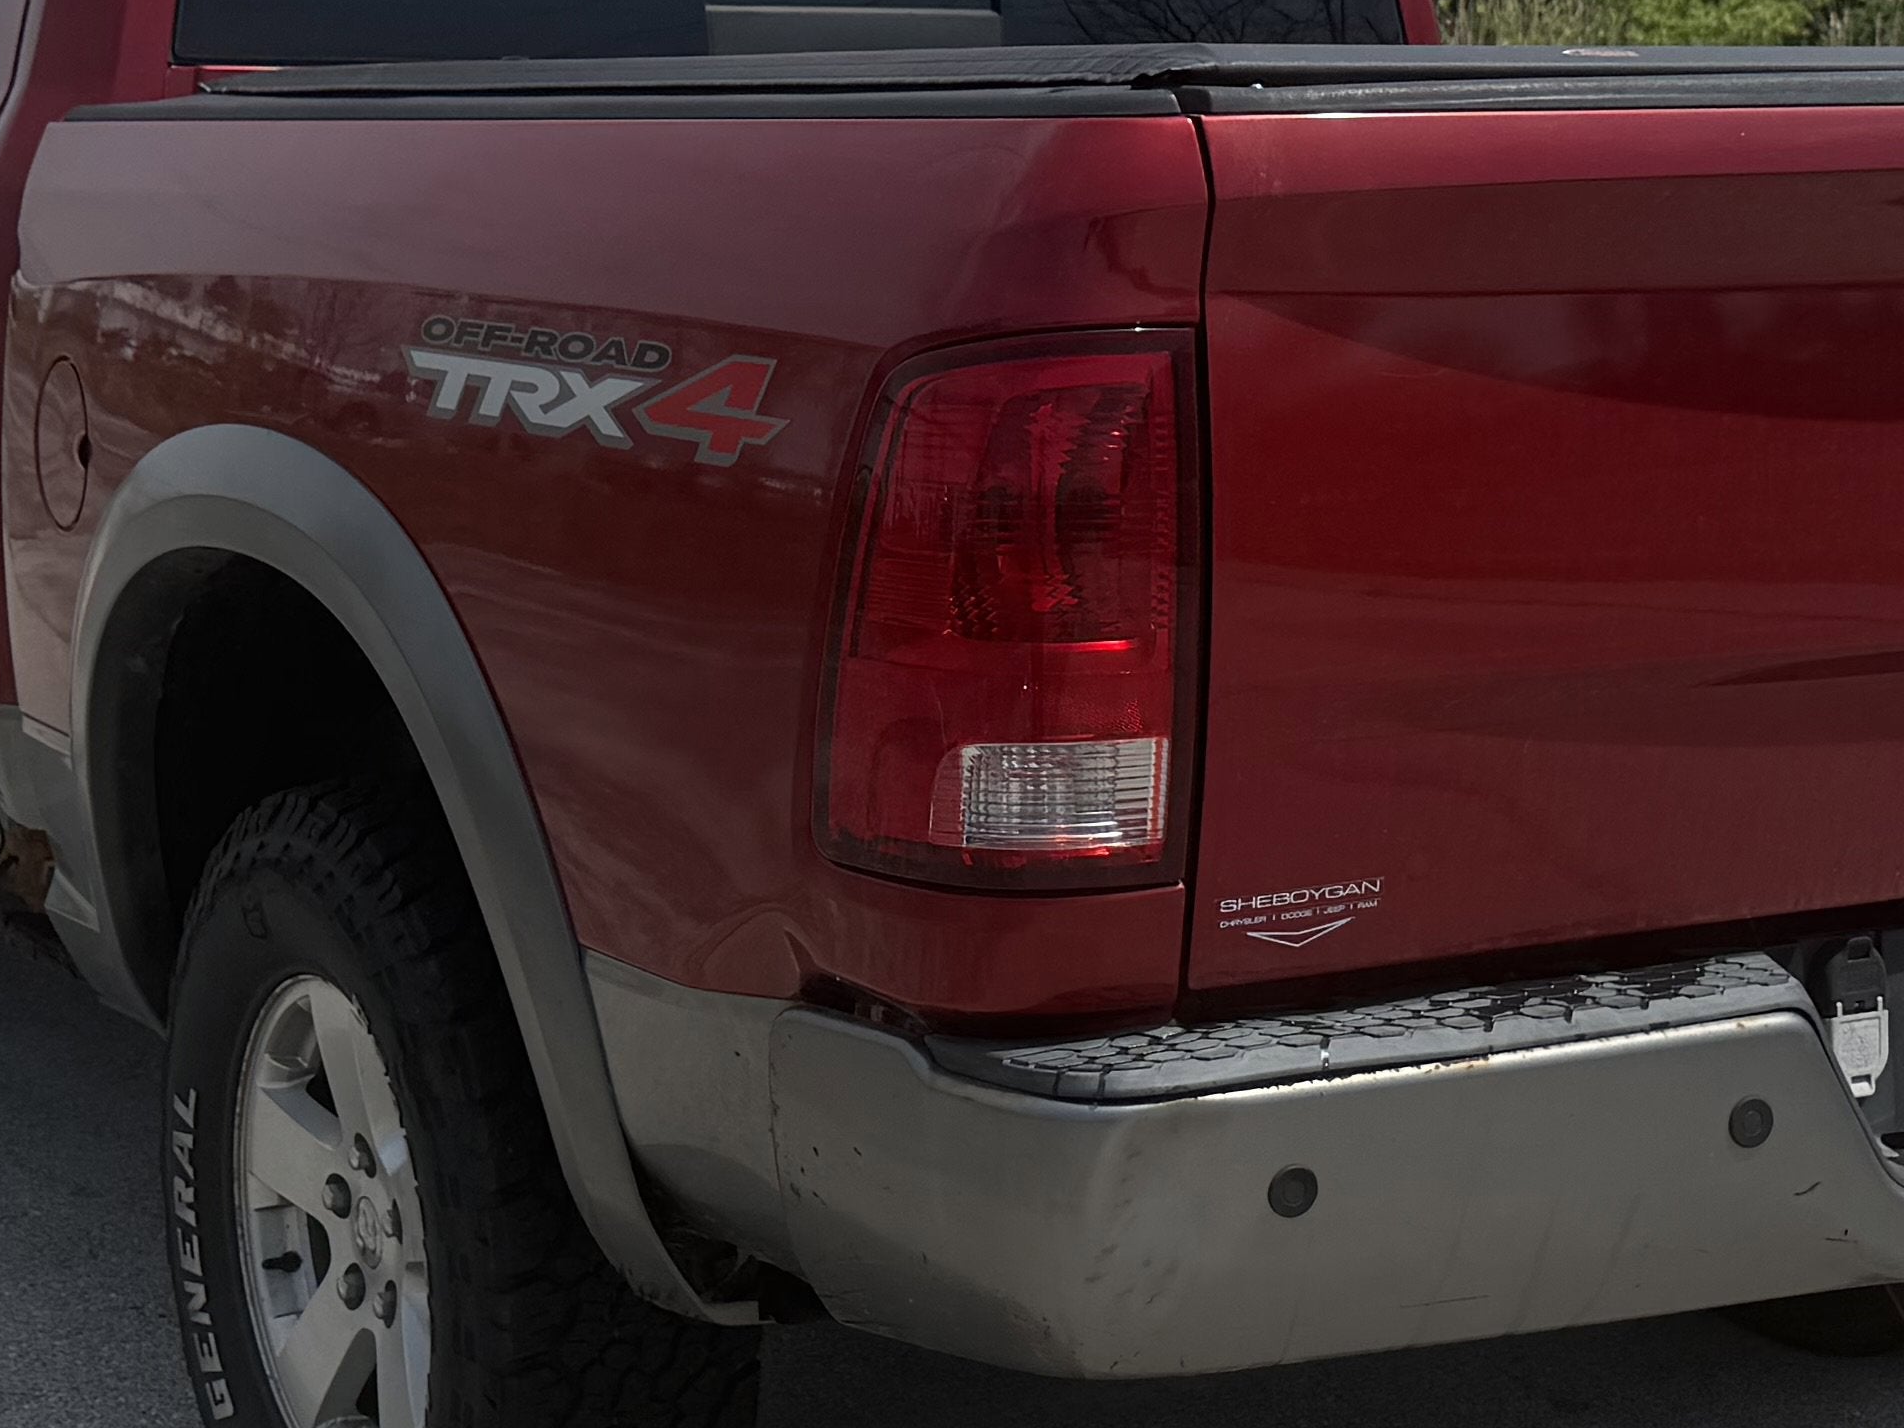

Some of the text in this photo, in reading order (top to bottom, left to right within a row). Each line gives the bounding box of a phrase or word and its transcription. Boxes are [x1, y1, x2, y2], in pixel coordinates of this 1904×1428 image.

[420, 315, 673, 372] OFF-ROAD
[1219, 878, 1381, 914] SHEBOYGAN
[1219, 900, 1379, 929] CHRYSLER DODGE JEEP RAM
[171, 1086, 236, 1421] GENERAL
